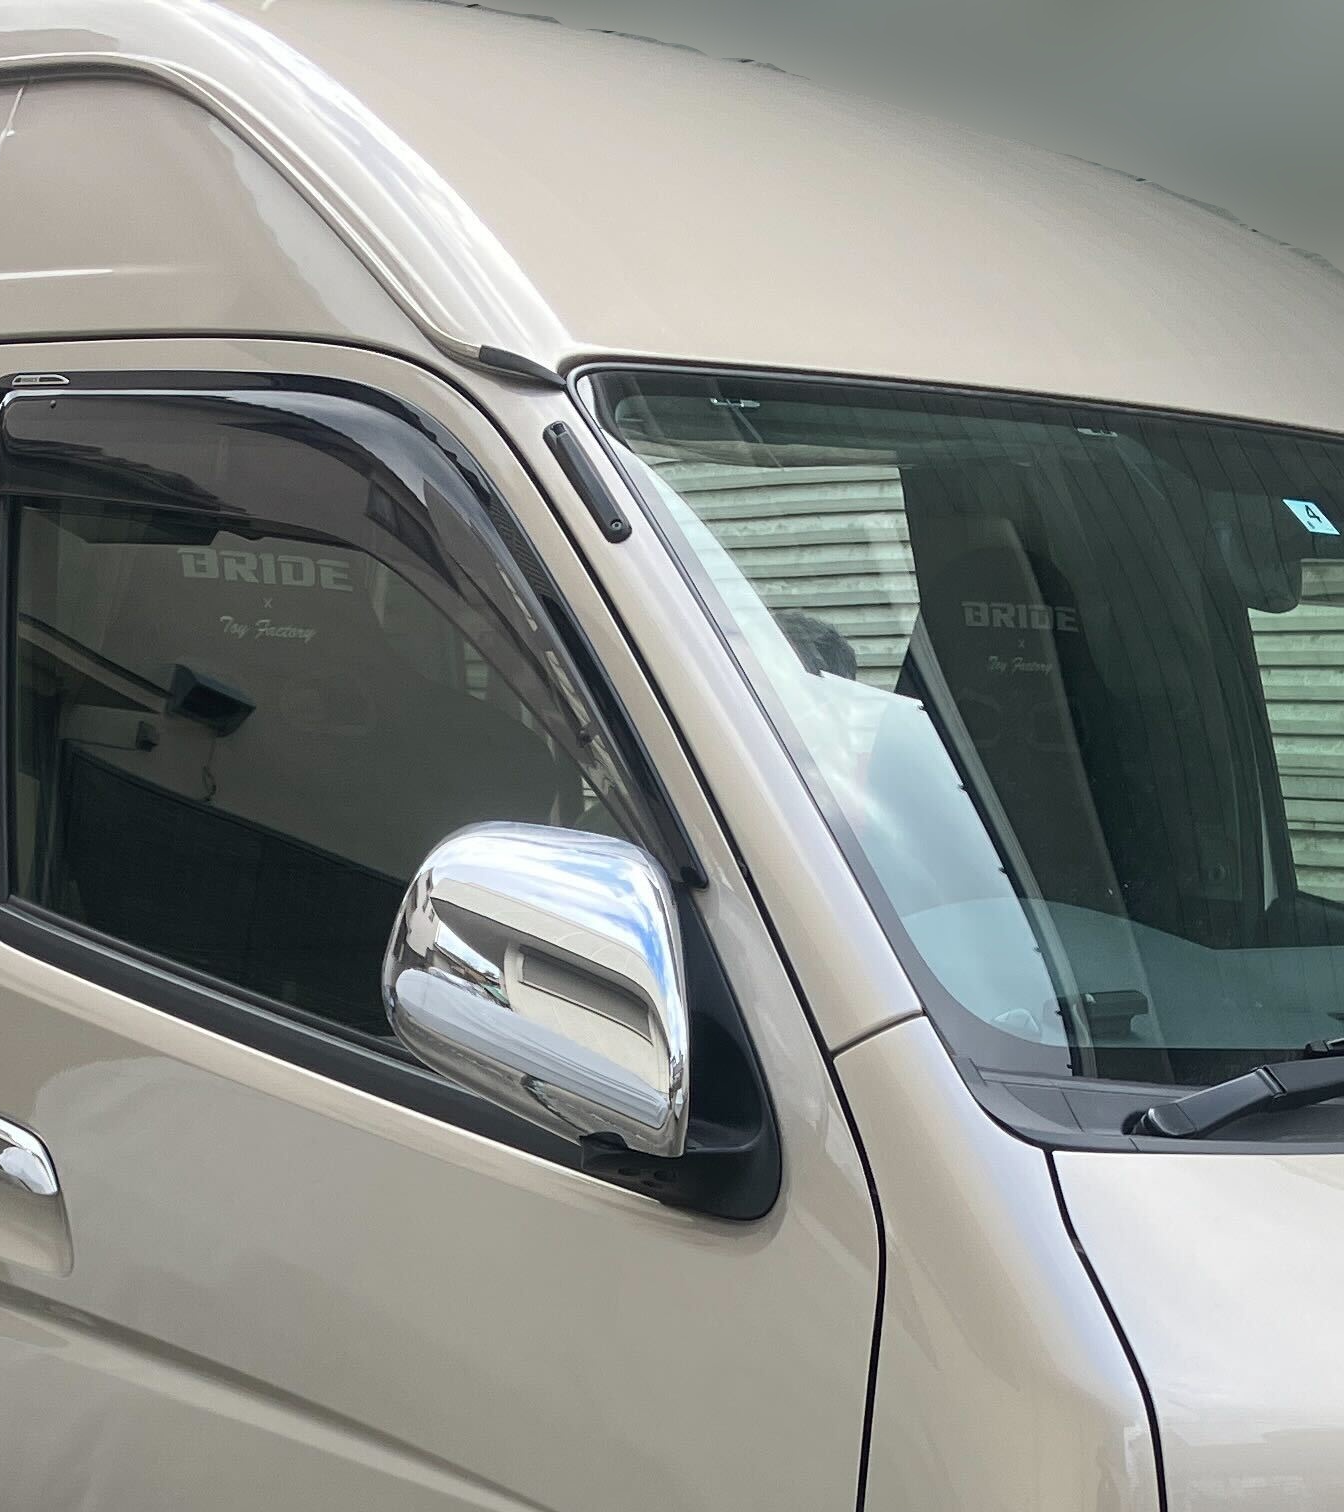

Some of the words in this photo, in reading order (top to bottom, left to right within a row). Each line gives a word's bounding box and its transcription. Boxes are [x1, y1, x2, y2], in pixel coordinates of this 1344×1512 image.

[1305, 504, 1322, 523] 4
[177, 548, 353, 592] BRIDE
[220, 616, 248, 638] Toy
[256, 619, 316, 643] Factory
[962, 601, 1079, 632] BRIDE
